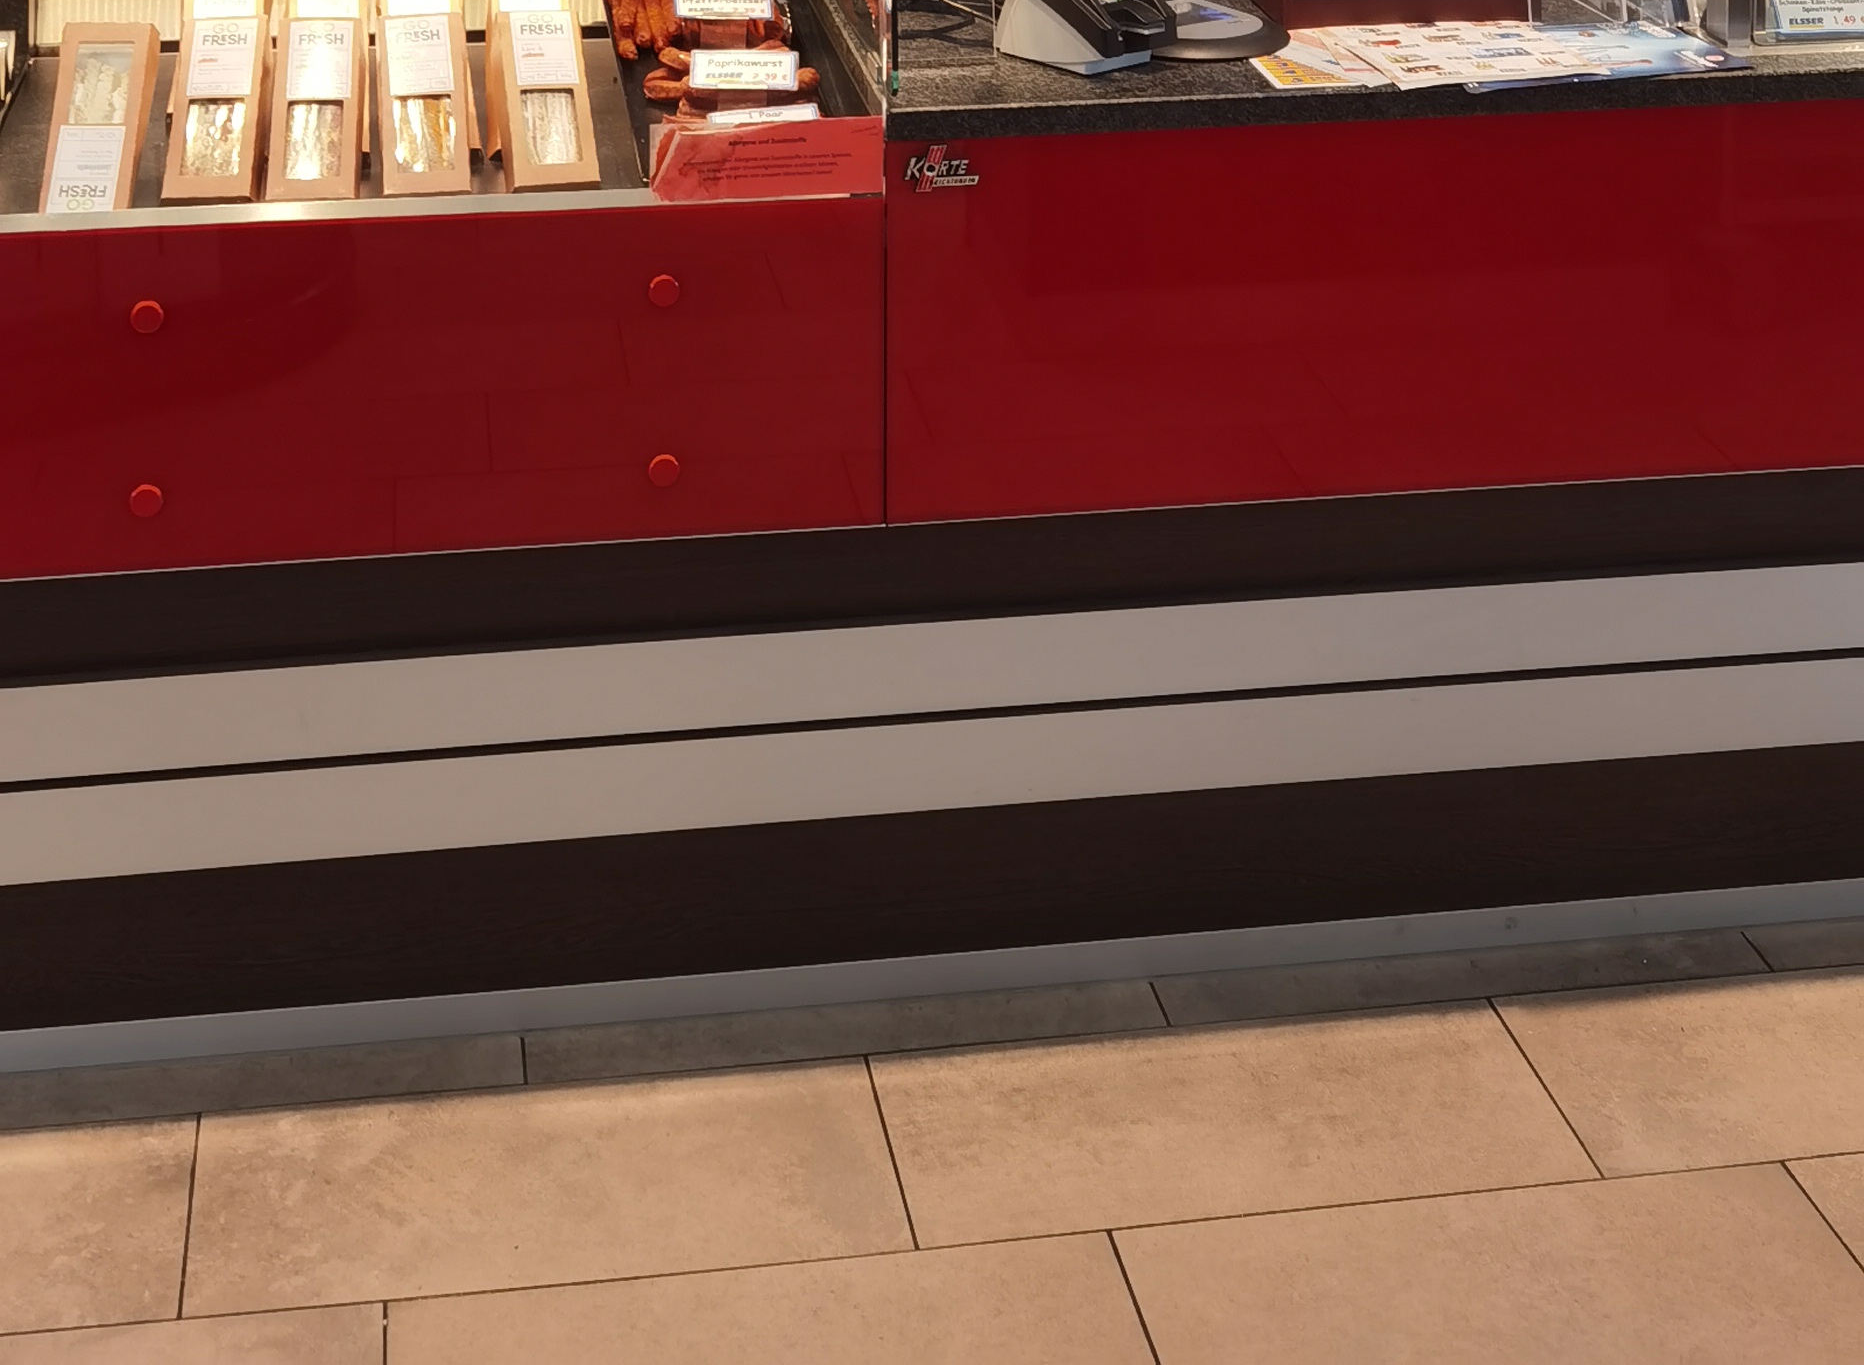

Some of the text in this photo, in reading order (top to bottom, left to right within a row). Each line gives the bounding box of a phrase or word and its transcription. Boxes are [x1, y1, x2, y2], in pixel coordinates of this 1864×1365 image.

[528, 14, 553, 24] GO
[1789, 17, 1824, 25] ELSSER
[213, 23, 239, 34] GO
[403, 20, 430, 30] GO
[520, 24, 564, 35] FRESH
[202, 34, 248, 46] FRESH
[396, 30, 441, 43] FRESH
[708, 58, 784, 69] Paprikawurst
[759, 110, 783, 118] Paar
[58, 184, 107, 198] FRESH
[66, 199, 95, 211] GO
